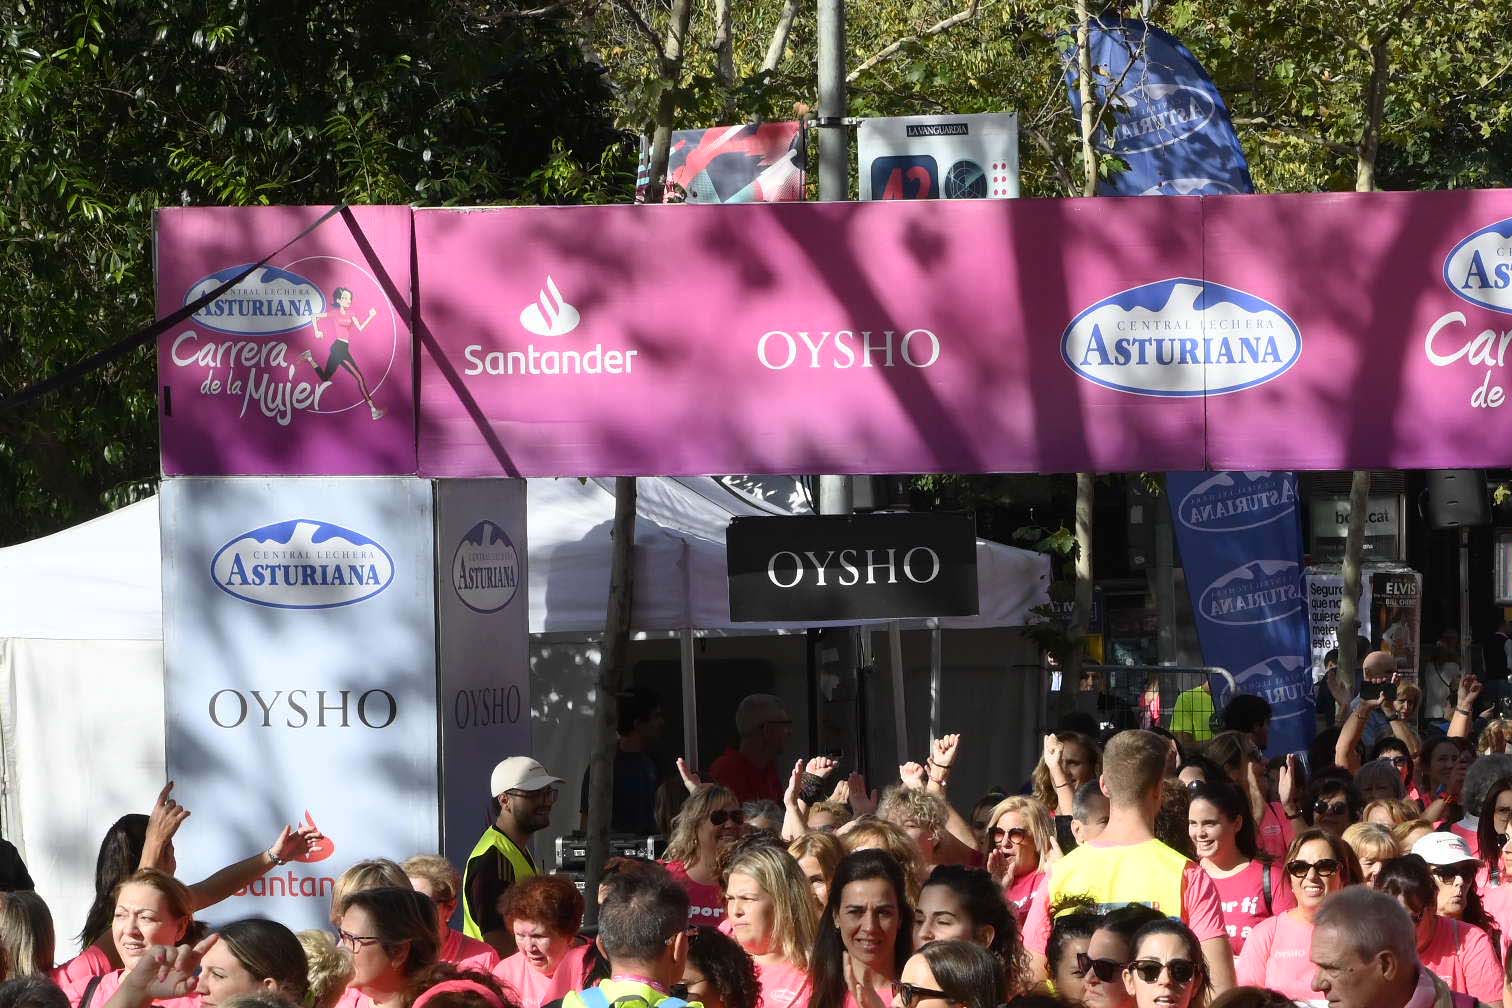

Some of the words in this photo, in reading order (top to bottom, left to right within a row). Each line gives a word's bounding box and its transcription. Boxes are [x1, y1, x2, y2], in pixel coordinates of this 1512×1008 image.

[919, 124, 967, 136] VANGUARDIA
[1117, 319, 1192, 332] CENTRAL
[1200, 318, 1275, 331] LECHERA
[171, 331, 288, 369] Carrera
[464, 343, 638, 376] Santander
[756, 328, 941, 370] OYSHO
[1080, 323, 1283, 366] ASTURIANA
[200, 369, 222, 395] de
[227, 366, 243, 395] la
[239, 364, 334, 427] Mujer
[1471, 366, 1506, 410] de
[225, 552, 381, 588] ASTURIANA
[253, 550, 310, 560] CENTRAL
[317, 550, 377, 560] LECHERA
[766, 546, 941, 588] OYSHO
[457, 556, 516, 591] ASTURIANA
[1386, 582, 1416, 595] ELVIS
[1312, 611, 1344, 624] quiere
[1312, 637, 1331, 649] este
[208, 688, 398, 729] OYSHO
[455, 683, 521, 730] OYSHO
